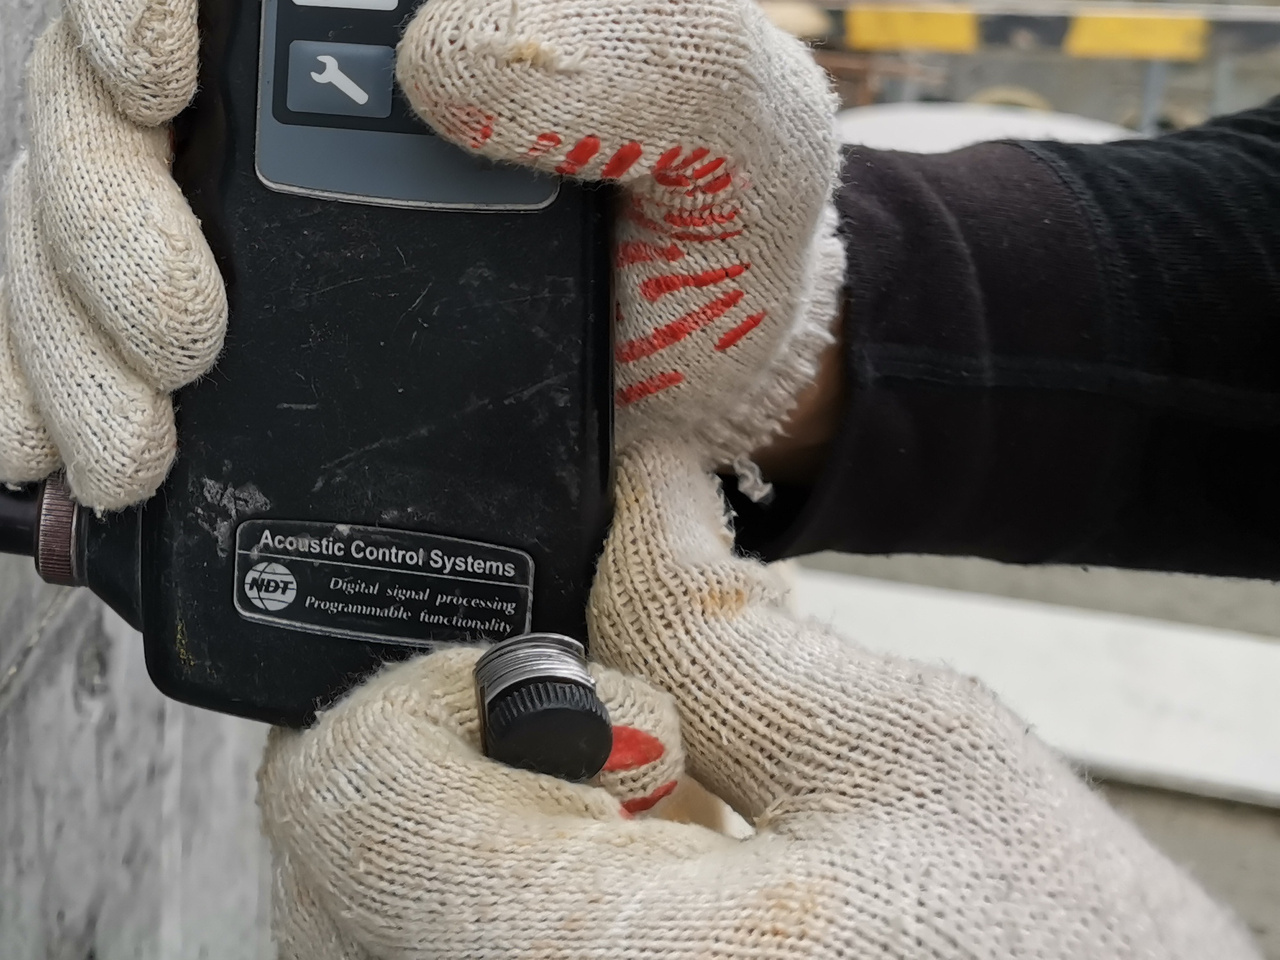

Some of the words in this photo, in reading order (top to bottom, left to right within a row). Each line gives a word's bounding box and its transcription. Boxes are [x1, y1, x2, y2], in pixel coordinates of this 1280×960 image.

[258, 529, 345, 557] Acoustic
[350, 540, 424, 566] Control
[430, 549, 516, 578] Systems
[247, 576, 295, 597] NDT
[329, 577, 380, 599] Digital
[386, 584, 430, 602] signal
[435, 591, 517, 616] processing
[305, 595, 412, 621] Programmable
[420, 609, 514, 635] functionality
